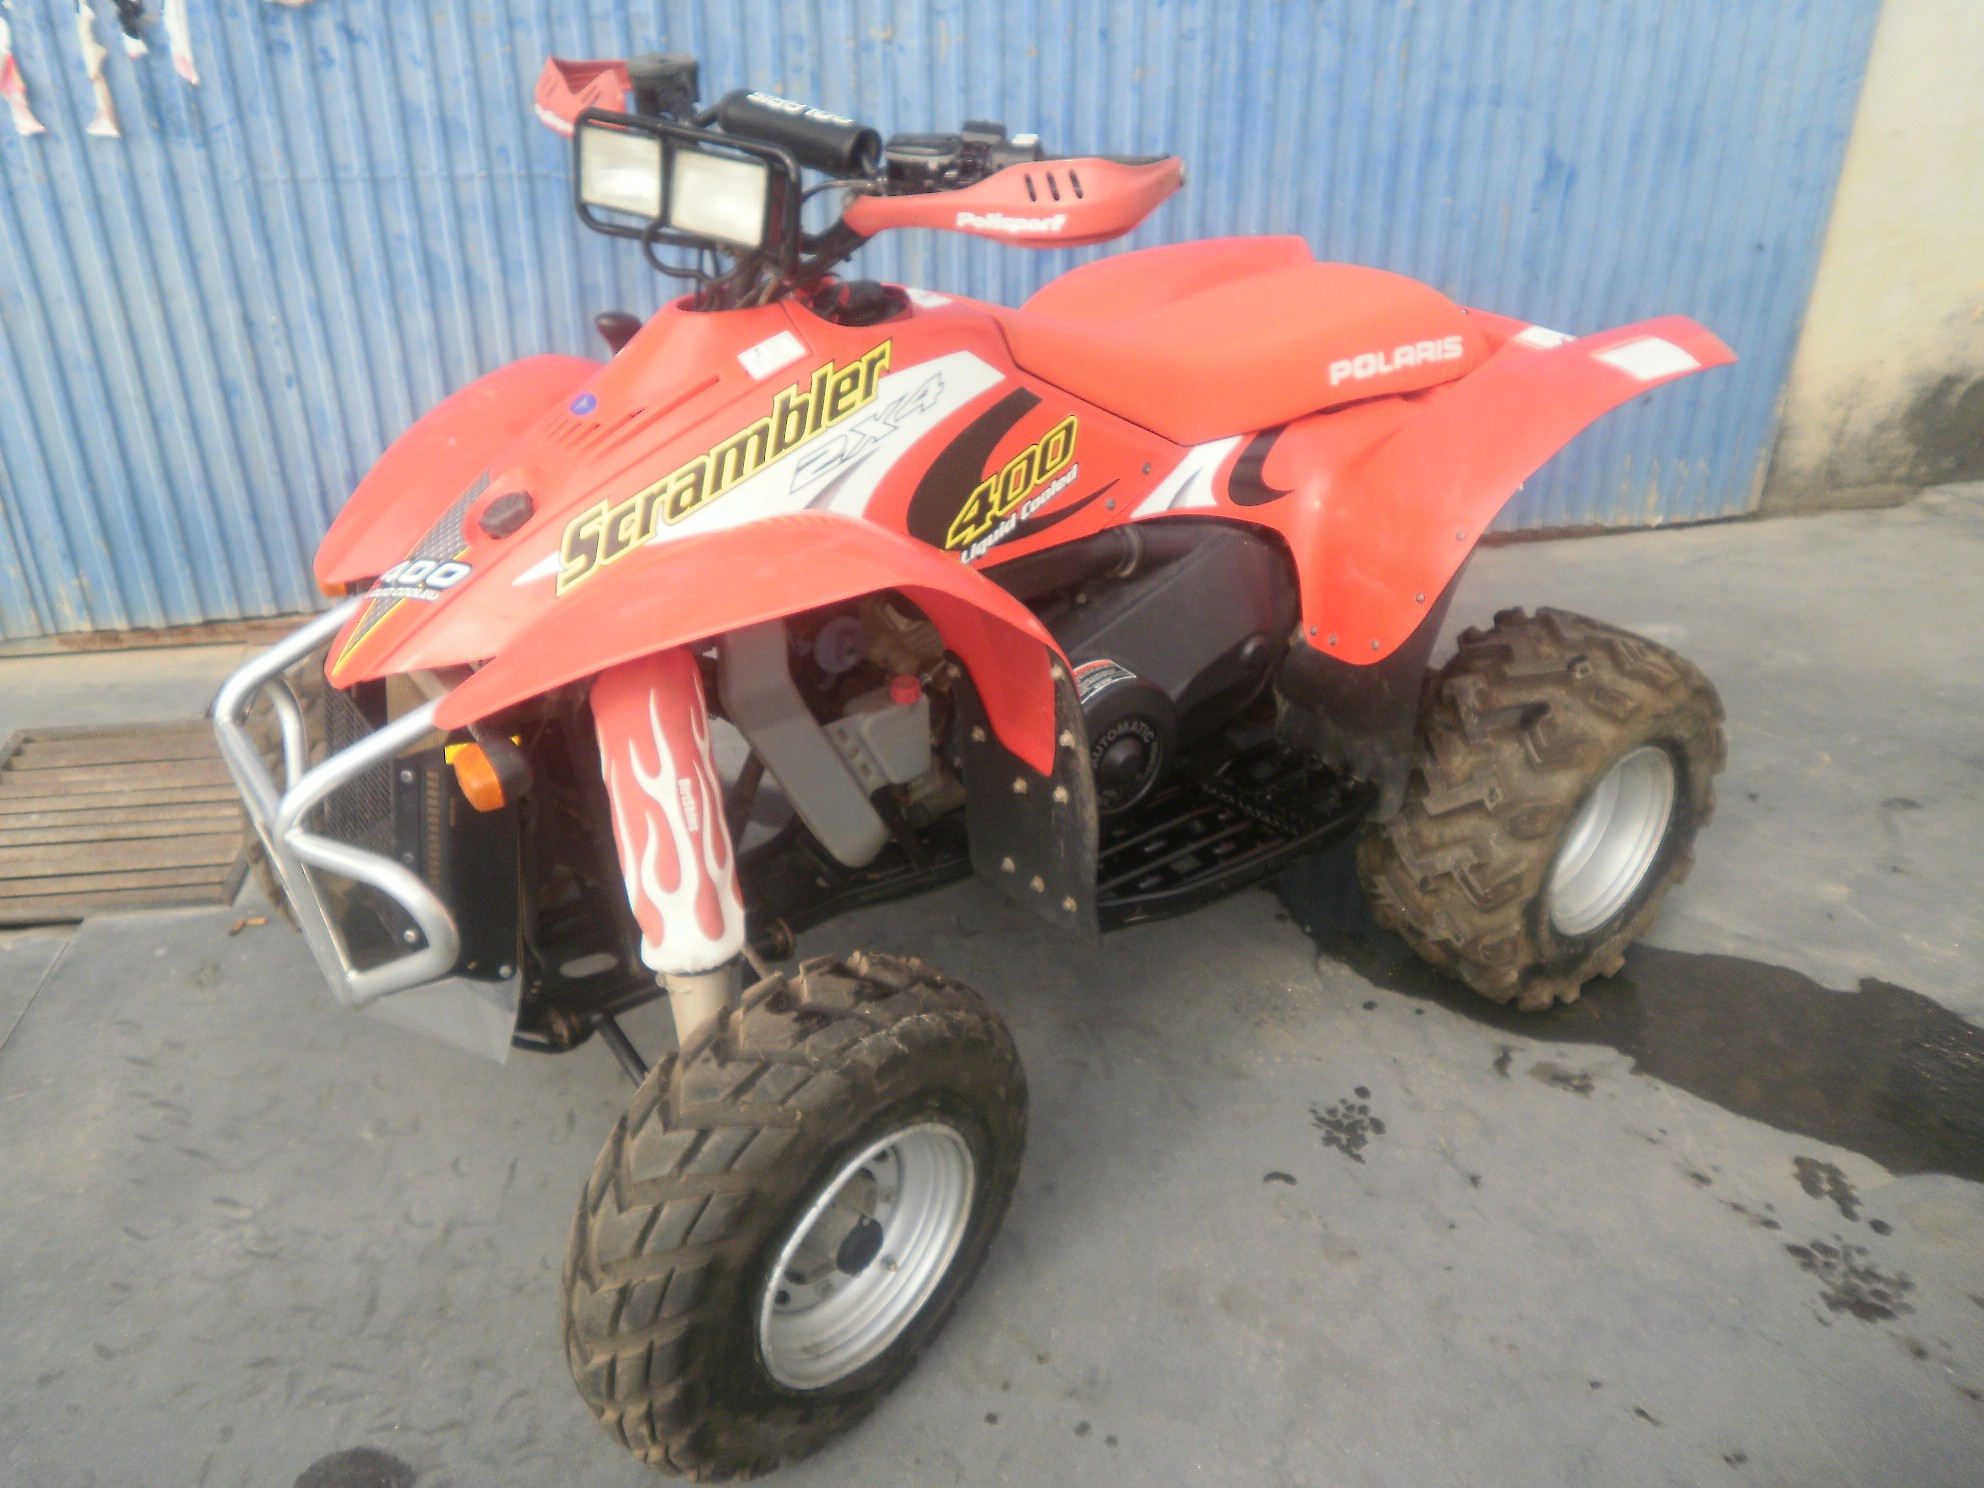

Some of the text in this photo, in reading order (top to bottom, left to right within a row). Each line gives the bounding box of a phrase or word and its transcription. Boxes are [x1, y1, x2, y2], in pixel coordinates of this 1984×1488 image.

[955, 211, 1068, 233] Polisport
[1329, 335, 1463, 386] POLARIS
[555, 338, 892, 597] Scrambler
[946, 415, 1078, 549] 400
[960, 462, 1079, 564] Liquid Cooled
